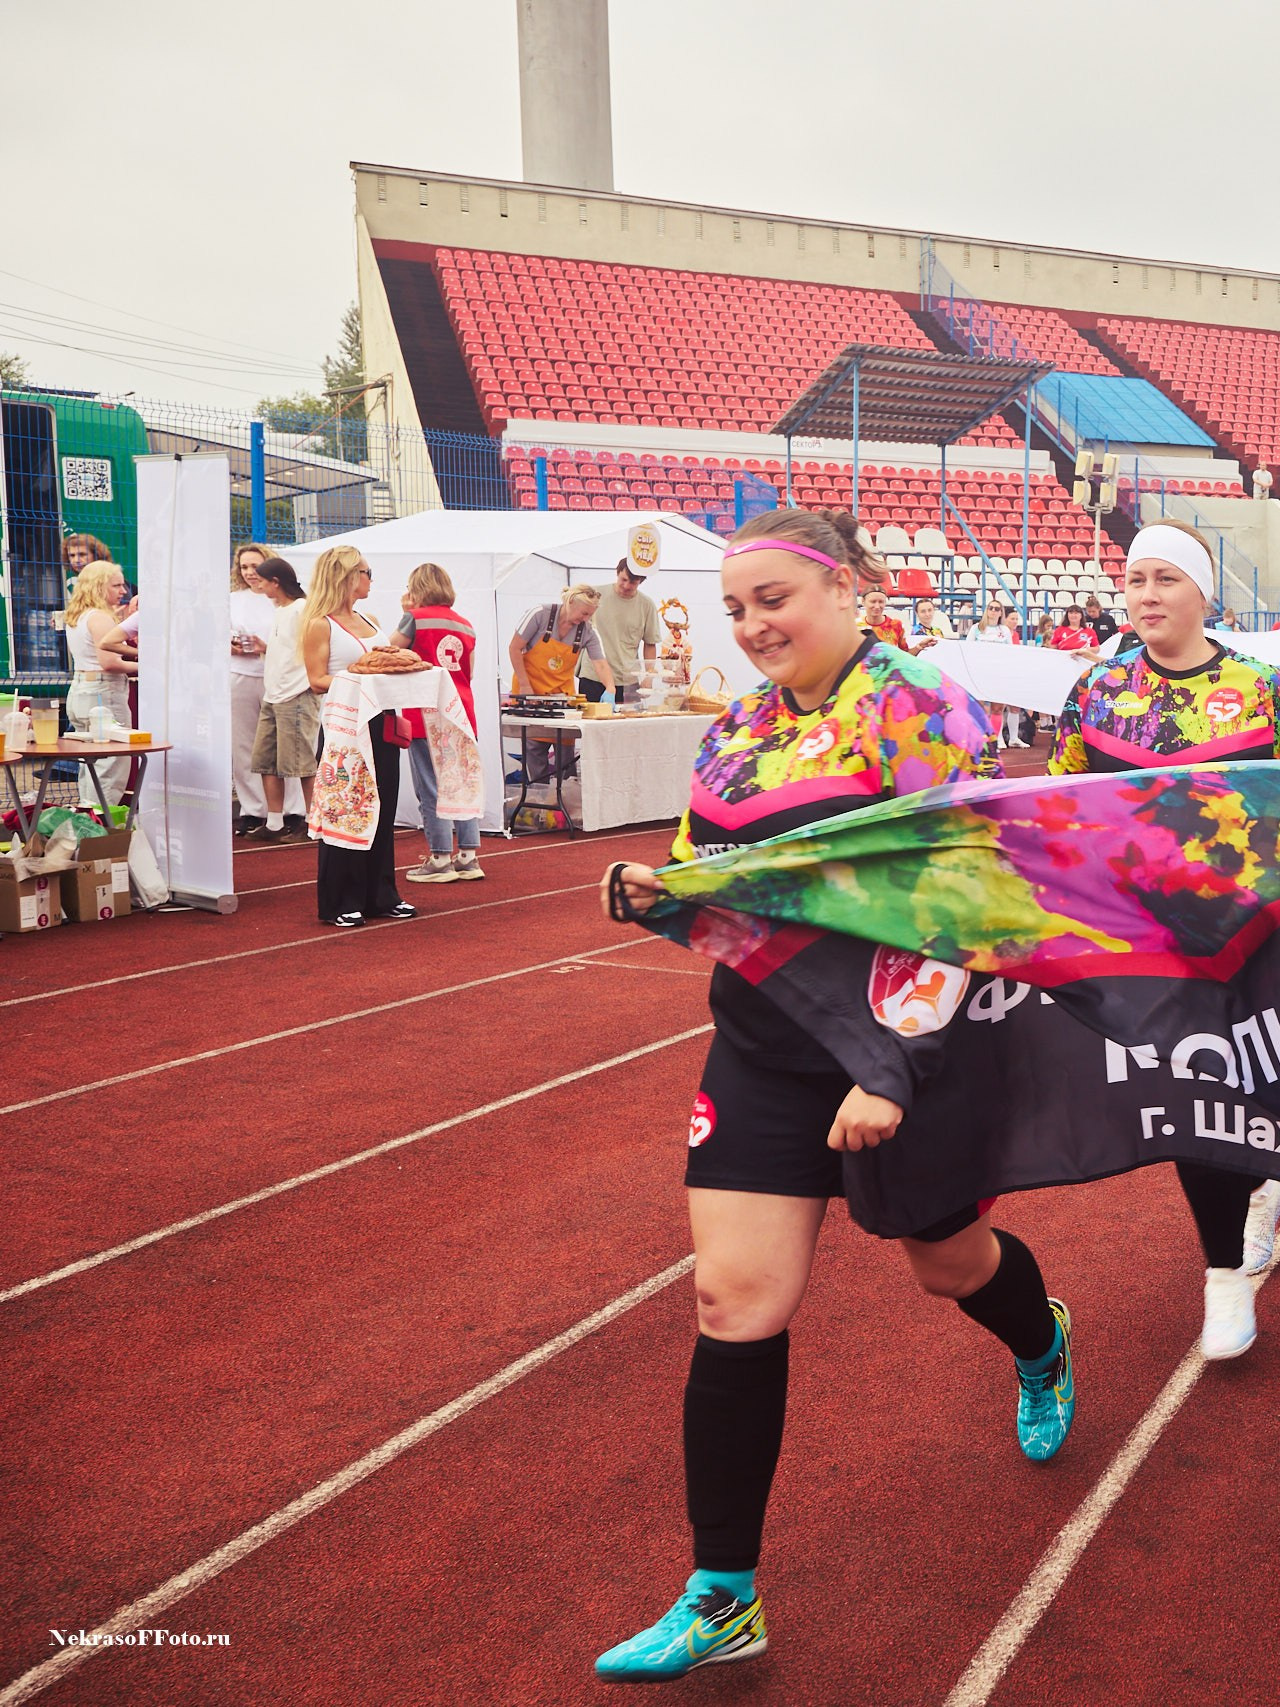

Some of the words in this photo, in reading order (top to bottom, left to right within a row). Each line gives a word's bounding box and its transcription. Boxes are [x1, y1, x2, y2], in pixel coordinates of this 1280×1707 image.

[1206, 701, 1242, 722] 52
[796, 730, 836, 761] 52
[1140, 1106, 1176, 1140] г.
